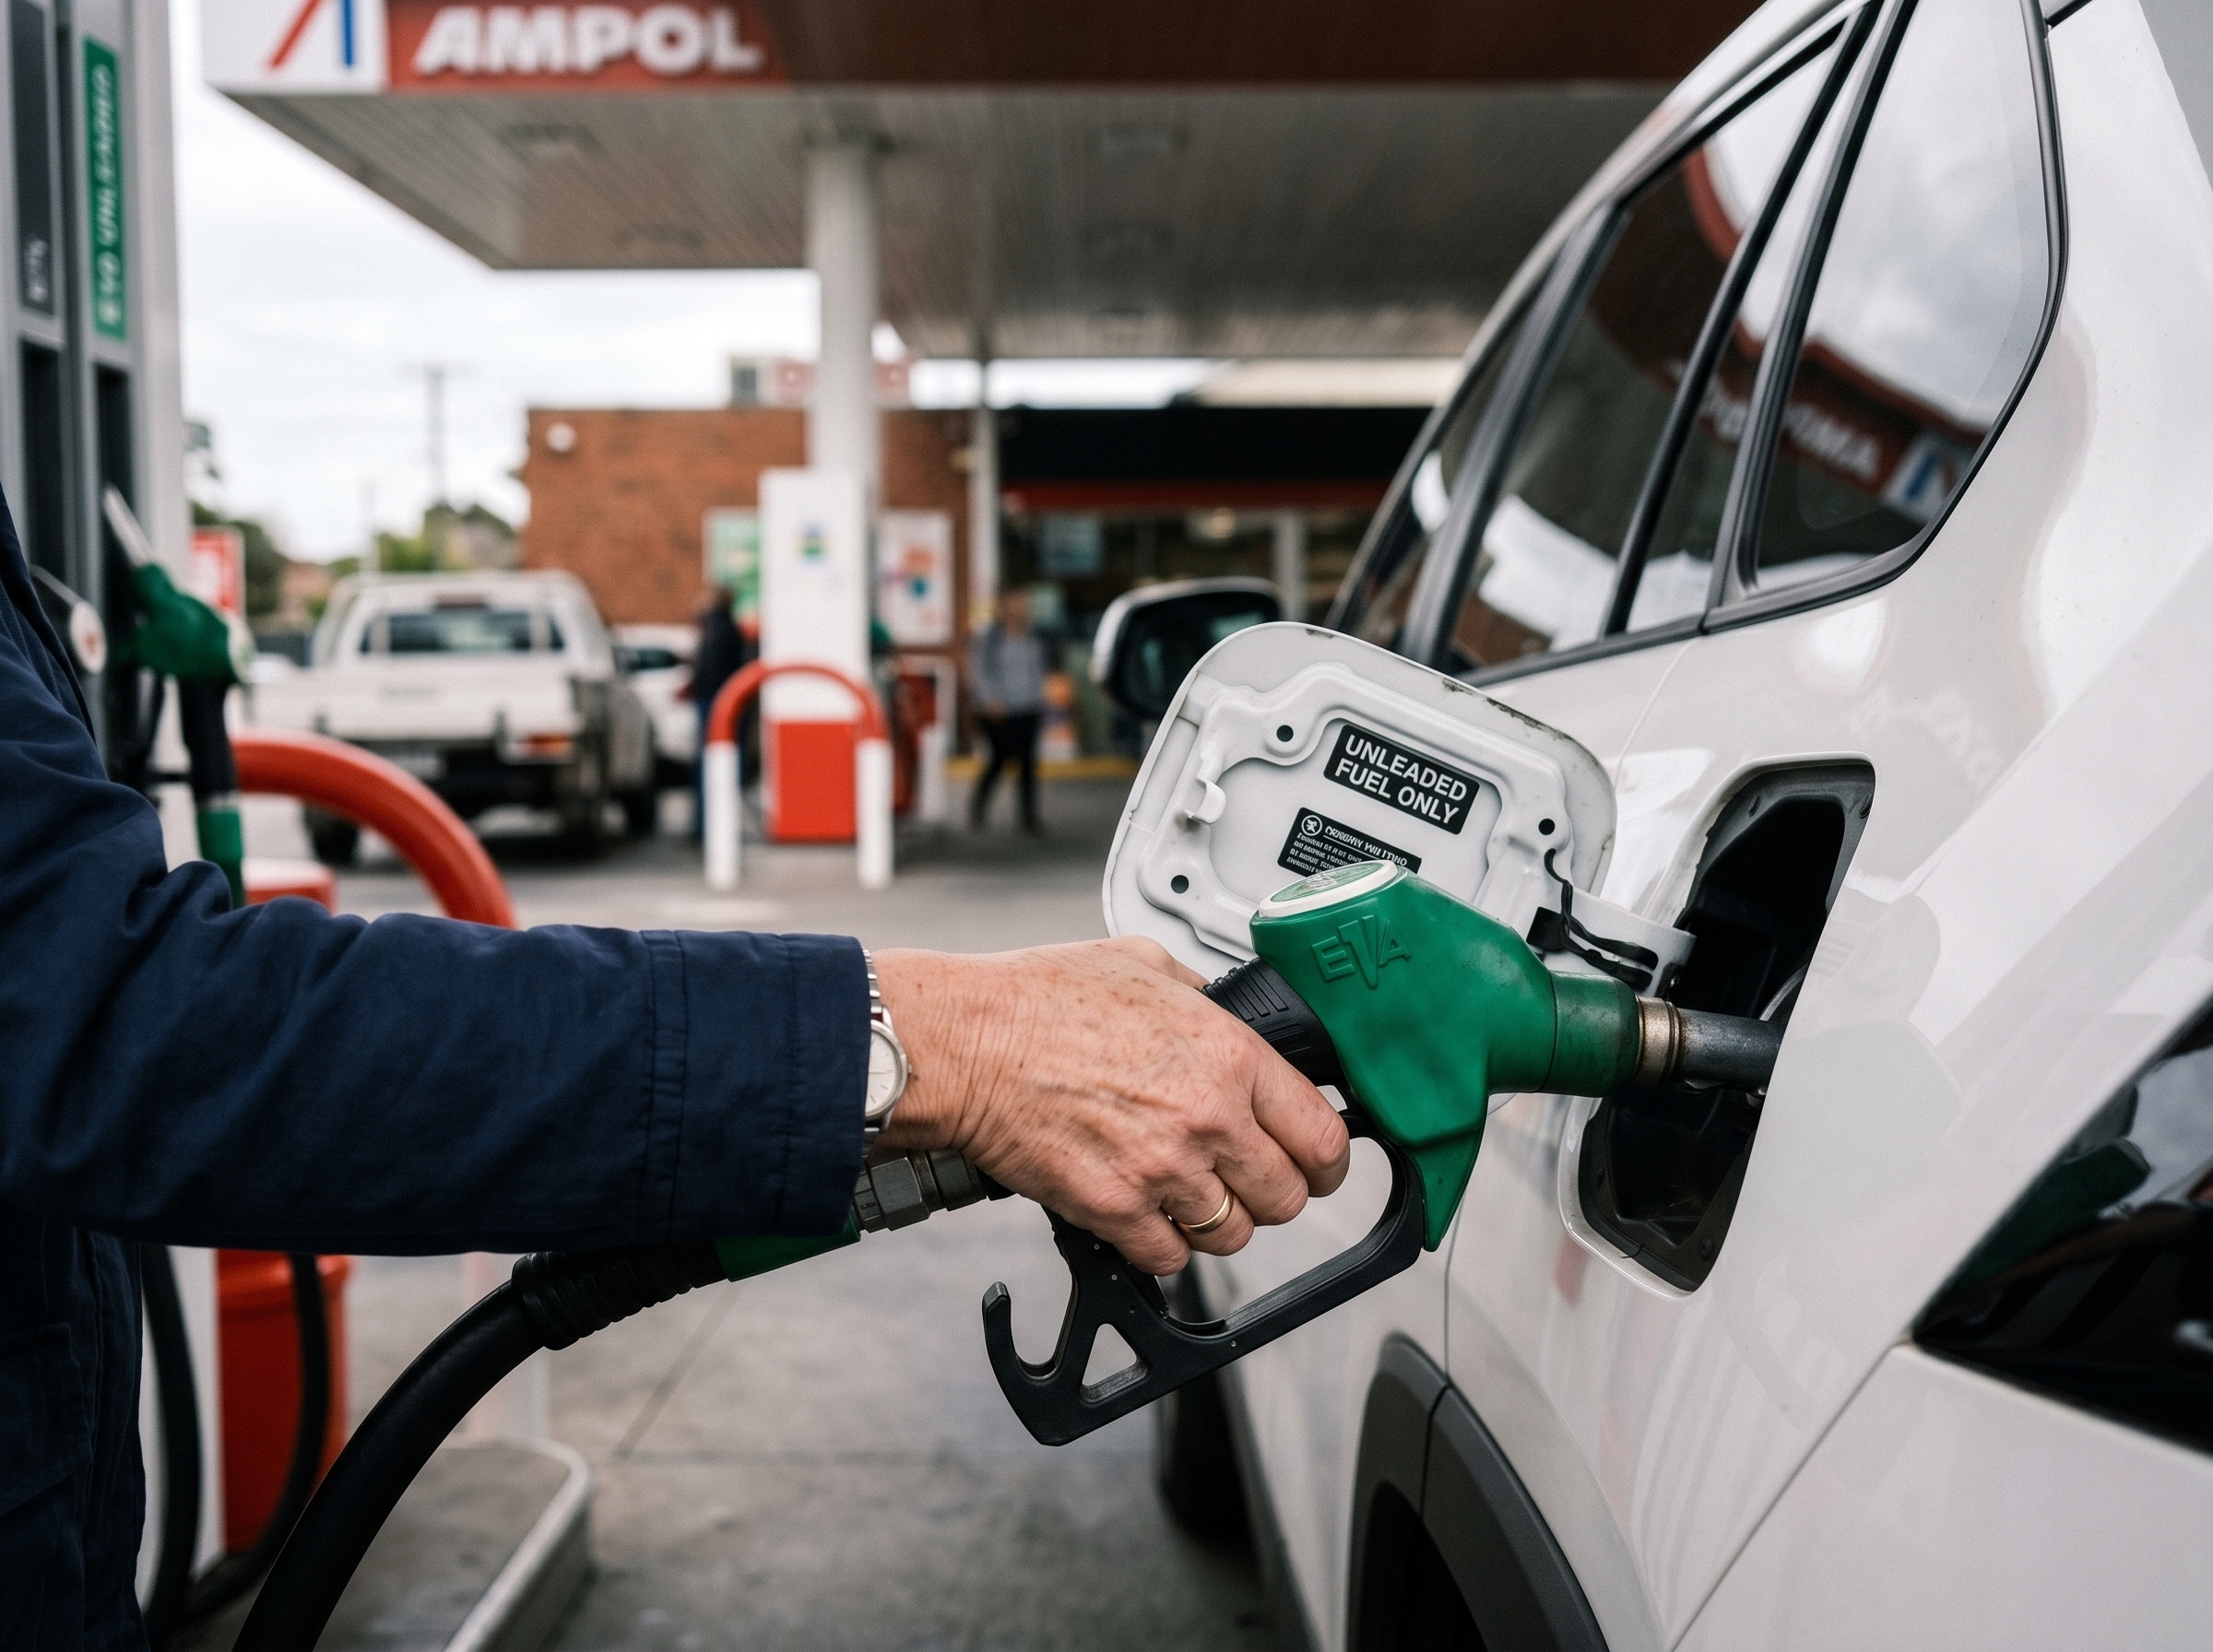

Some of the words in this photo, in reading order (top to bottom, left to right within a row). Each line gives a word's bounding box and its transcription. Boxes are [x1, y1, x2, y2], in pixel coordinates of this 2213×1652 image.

[411, 4, 765, 75] AMPOL
[1334, 758, 1391, 799] FUEL
[1397, 785, 1460, 824] ONLY
[1345, 735, 1467, 801] UNLEADED
